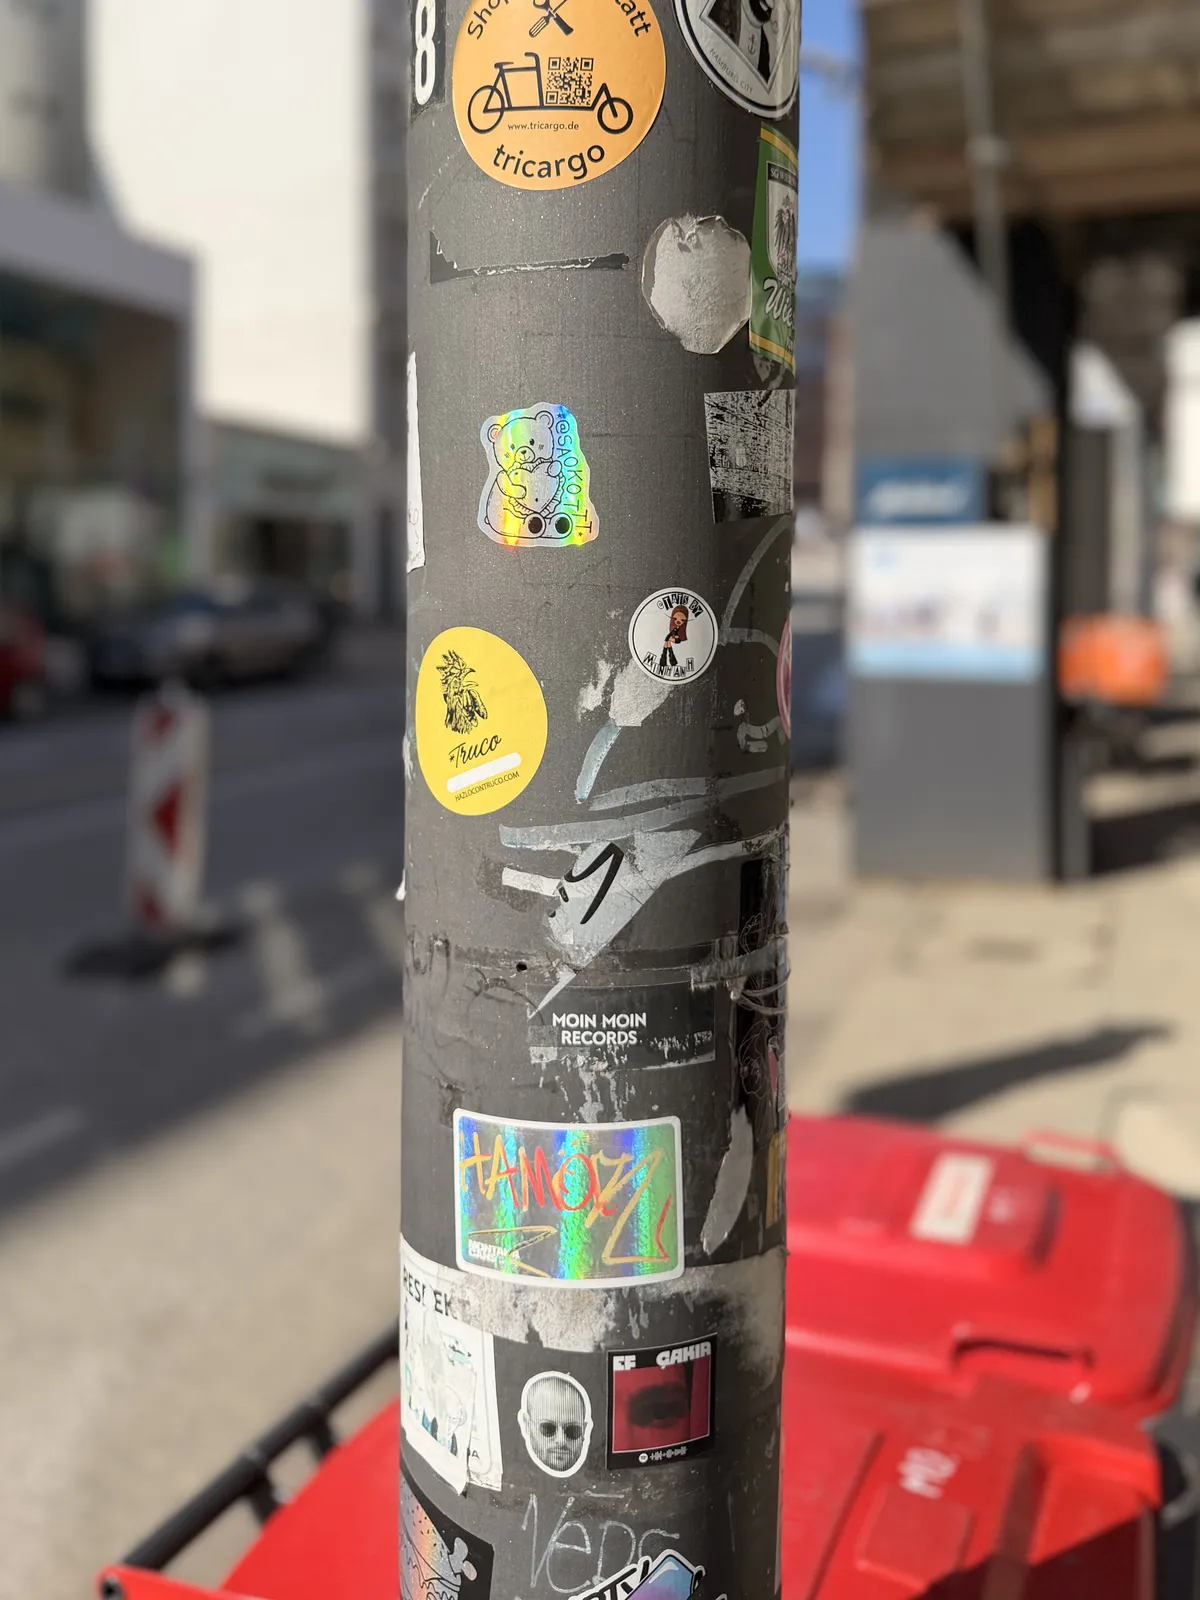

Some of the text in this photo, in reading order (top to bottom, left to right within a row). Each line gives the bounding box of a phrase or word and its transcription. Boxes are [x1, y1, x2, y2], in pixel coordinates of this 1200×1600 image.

[507, 120, 580, 132] www.tricargo.de
[492, 144, 606, 180] tricargo
[454, 771, 520, 802] HAZLOCONTRUCO.COM
[552, 1012, 647, 1029] MOIN MOIN
